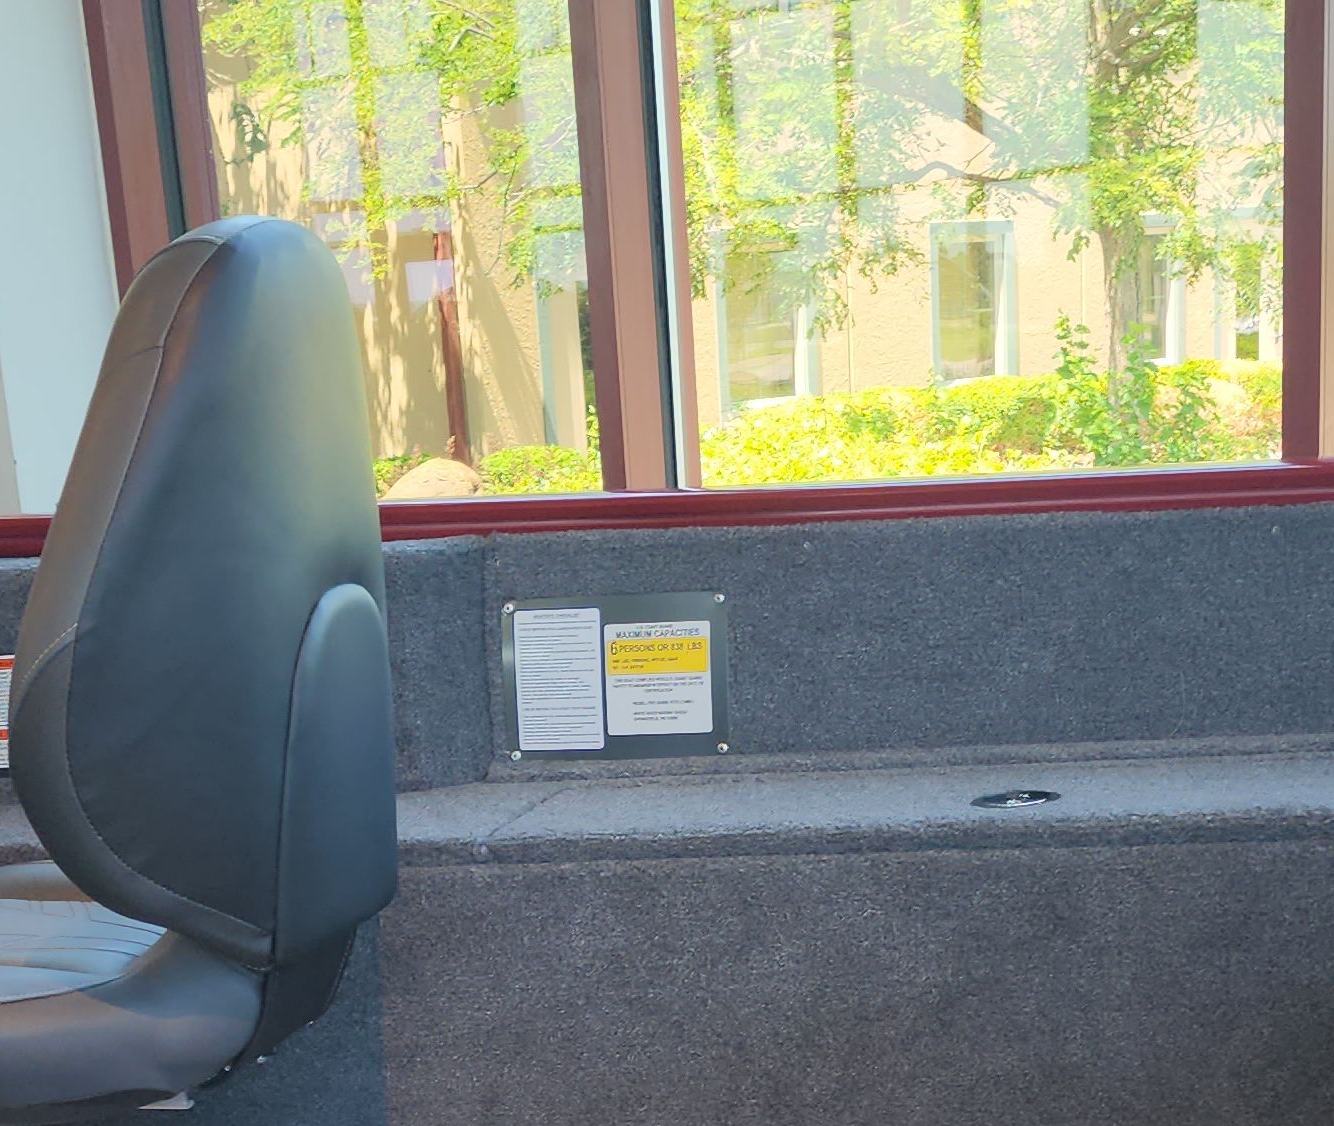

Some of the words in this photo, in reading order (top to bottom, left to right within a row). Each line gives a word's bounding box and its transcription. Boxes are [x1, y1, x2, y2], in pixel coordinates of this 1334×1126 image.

[615, 629, 652, 639] MAXIMUM
[653, 628, 700, 638] CAPACITIES
[610, 641, 618, 655] 6
[619, 644, 655, 653] PERSONS
[657, 643, 669, 652] OR
